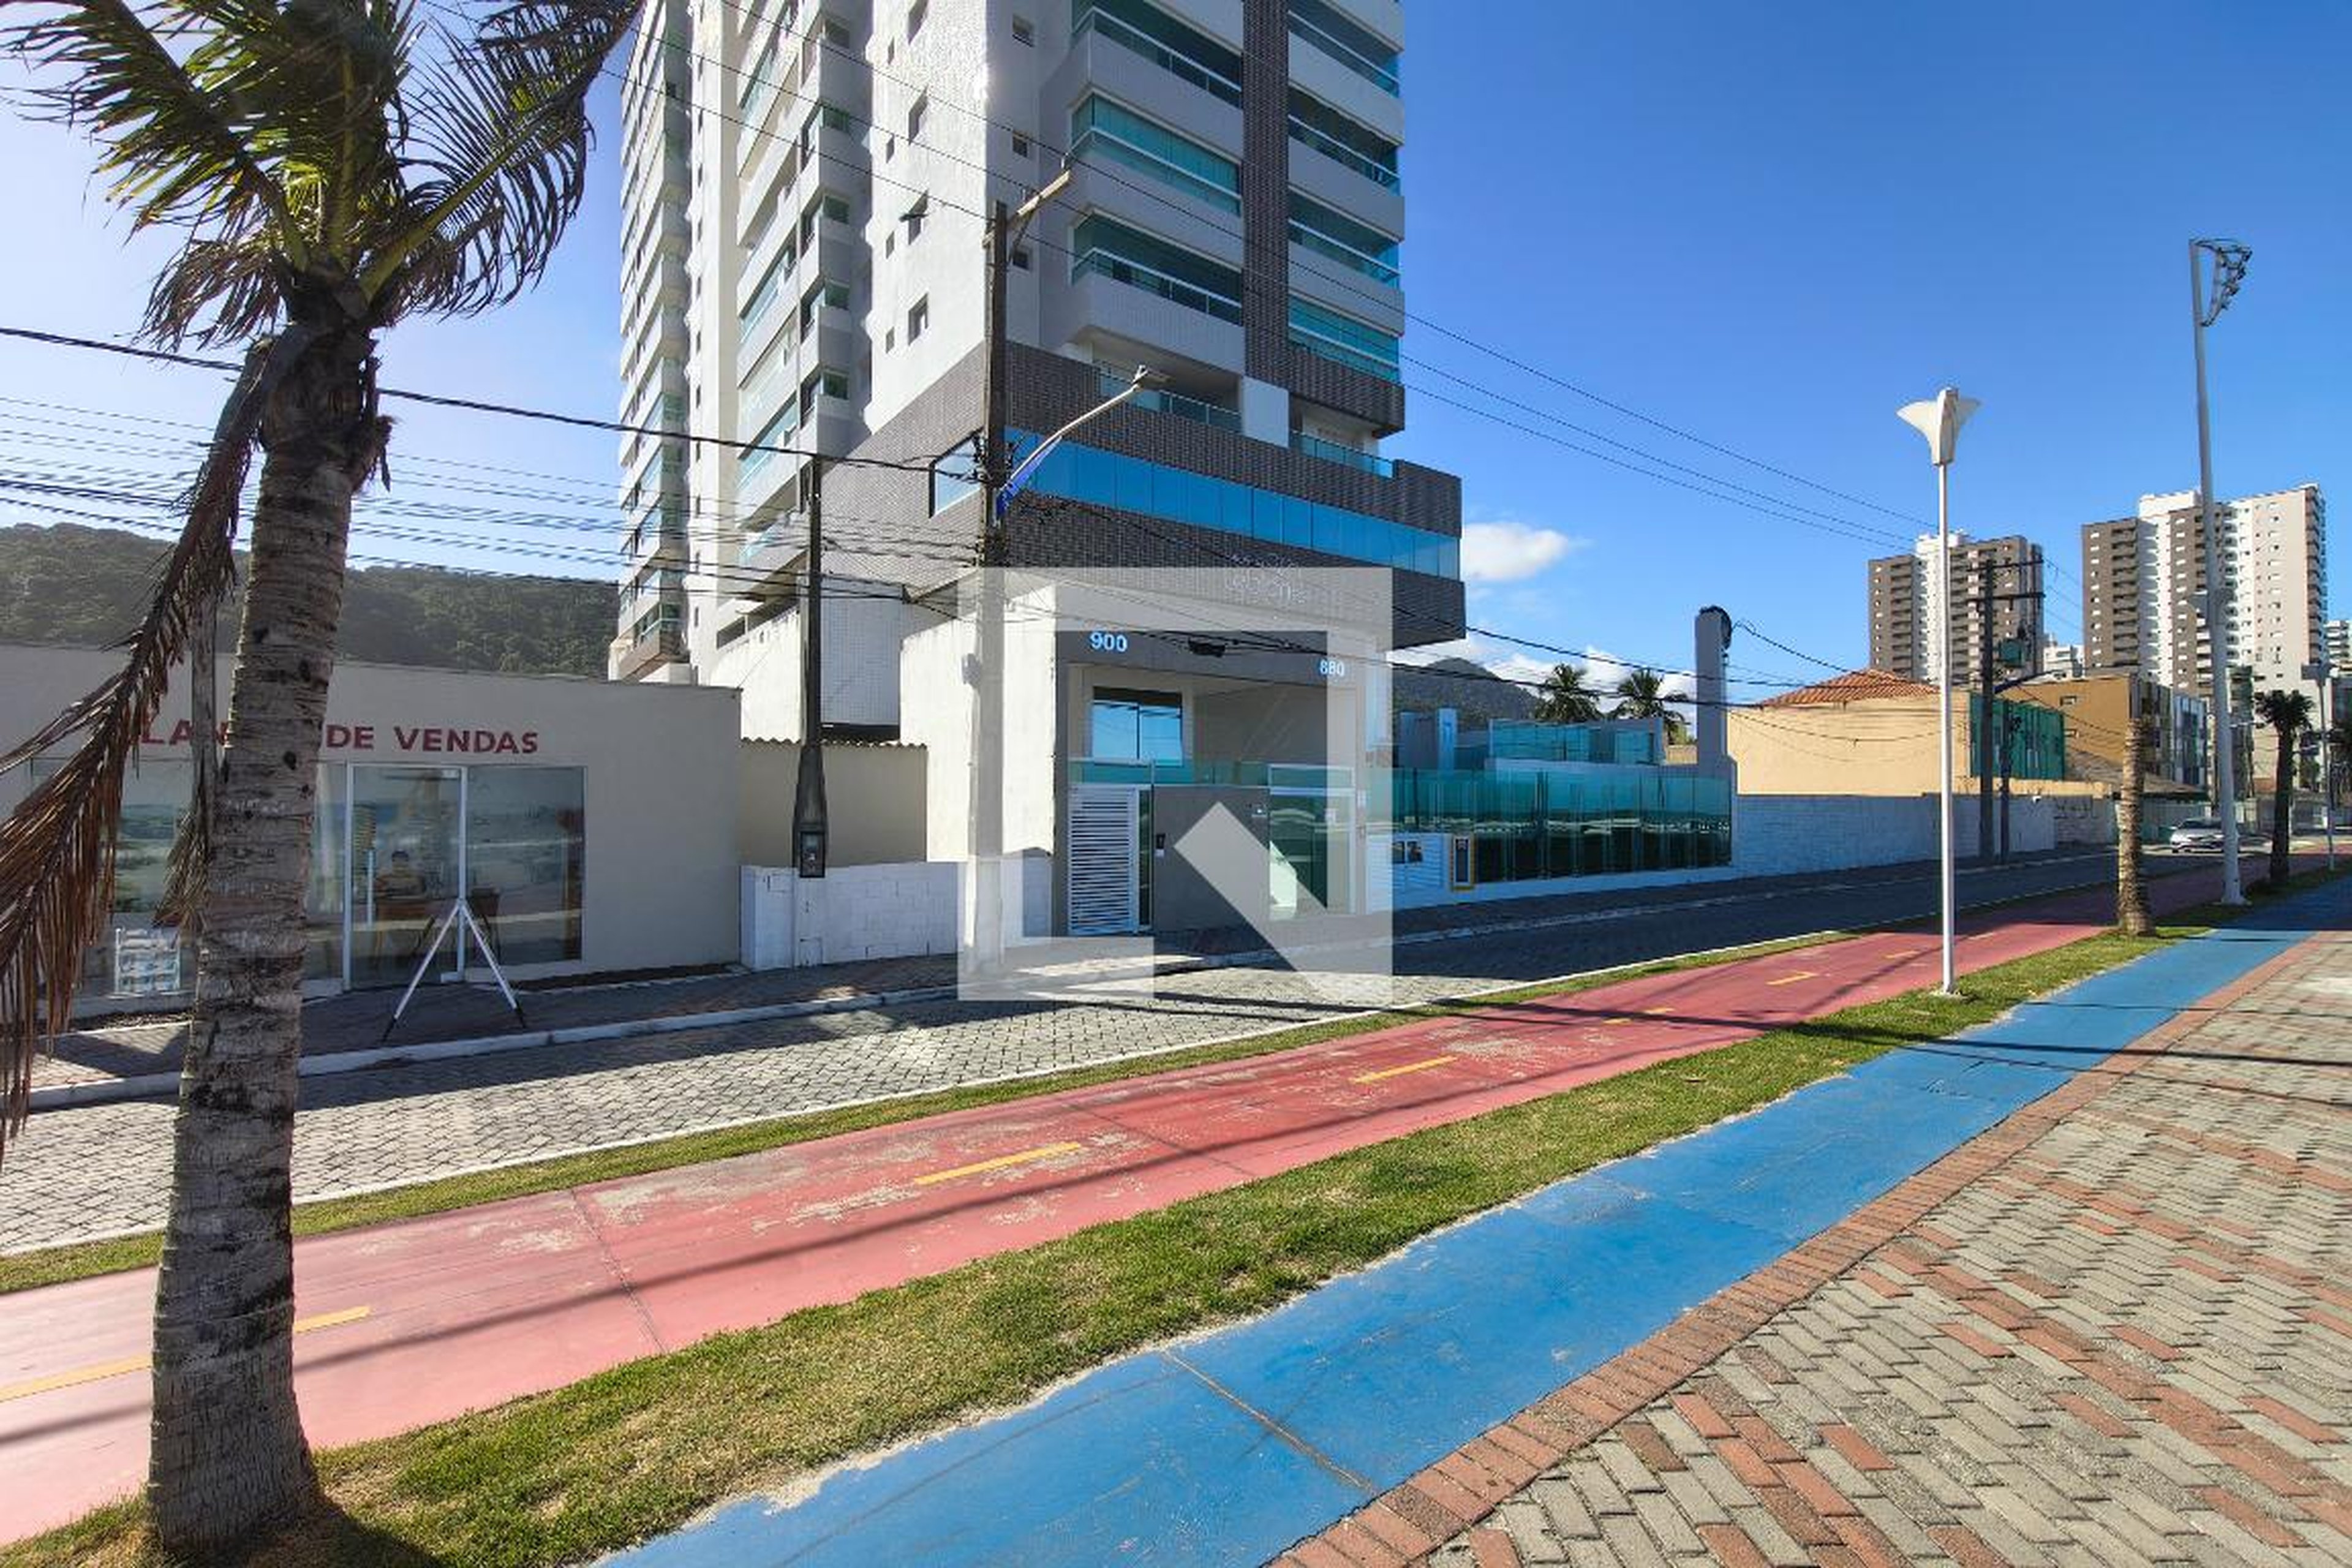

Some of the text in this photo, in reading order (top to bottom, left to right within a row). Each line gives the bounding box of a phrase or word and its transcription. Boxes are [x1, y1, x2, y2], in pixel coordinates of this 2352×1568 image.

[1090, 632, 1128, 652] 900
[326, 725, 538, 754] DE VENDAS
